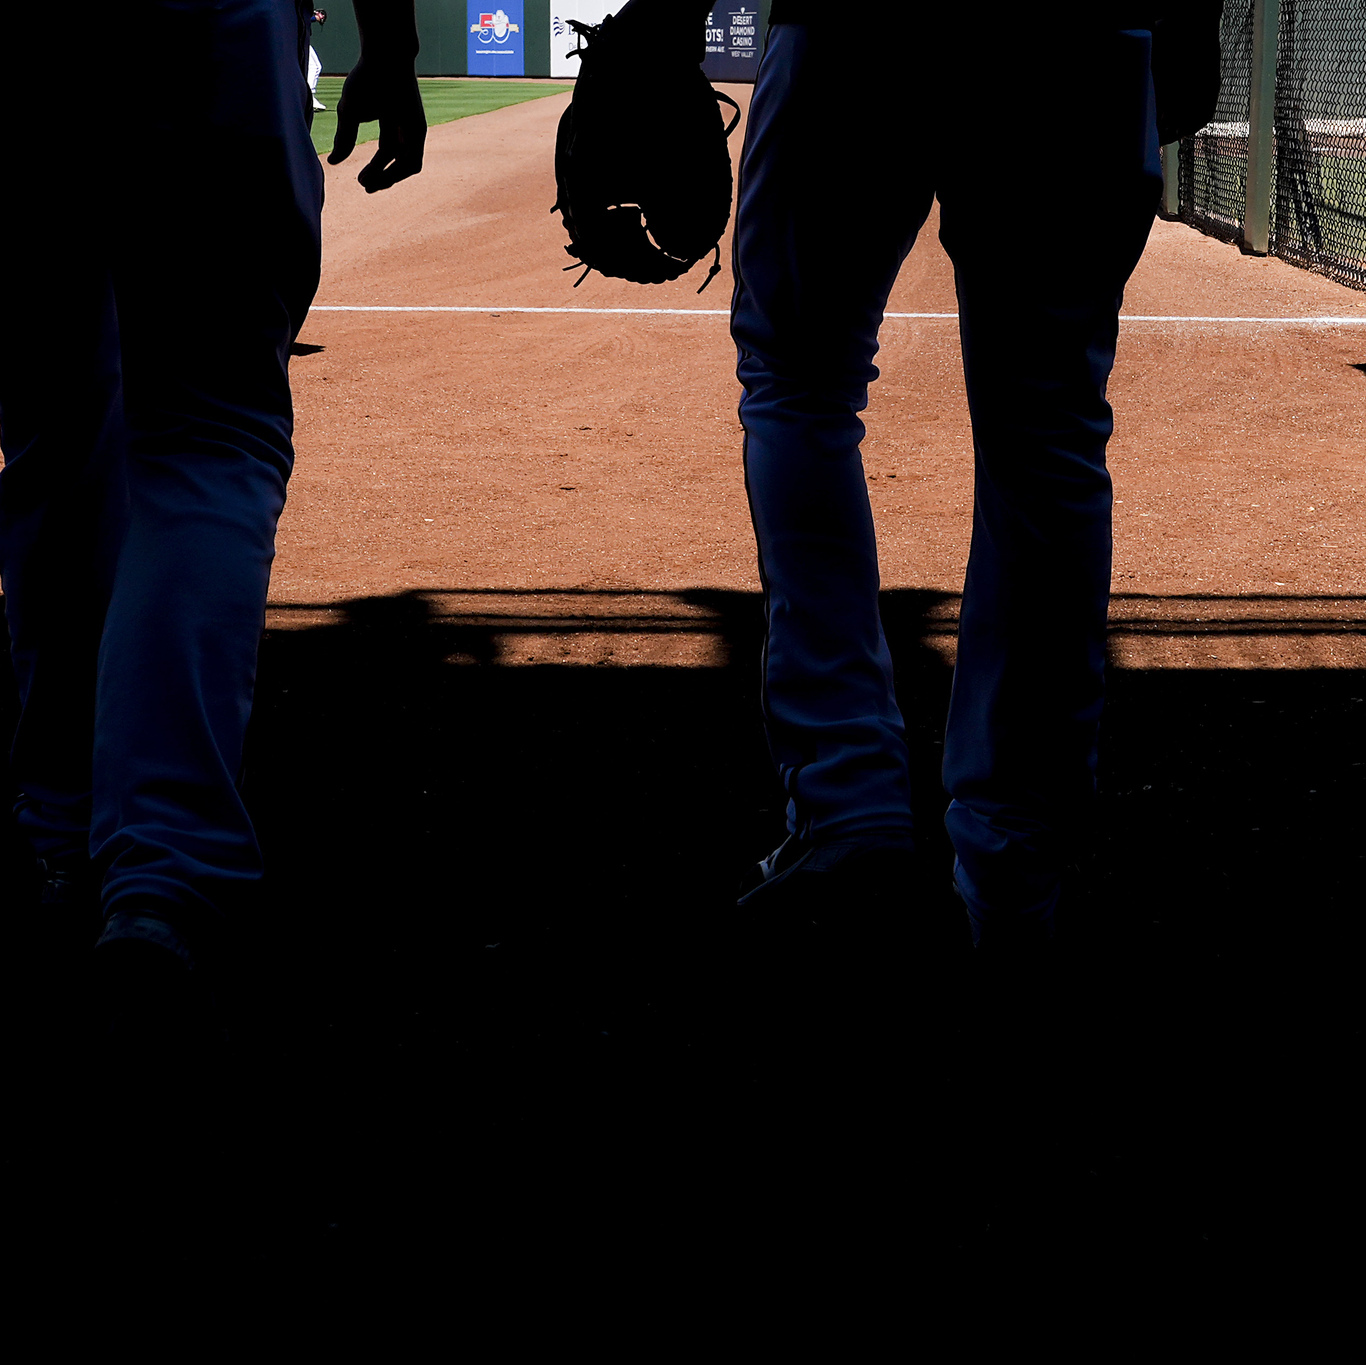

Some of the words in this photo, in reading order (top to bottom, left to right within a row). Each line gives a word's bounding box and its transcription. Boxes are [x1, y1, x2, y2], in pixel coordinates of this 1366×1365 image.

[732, 15, 753, 25] DESERT
[729, 26, 755, 36] DIAMOND
[732, 36, 753, 46] CASINO
